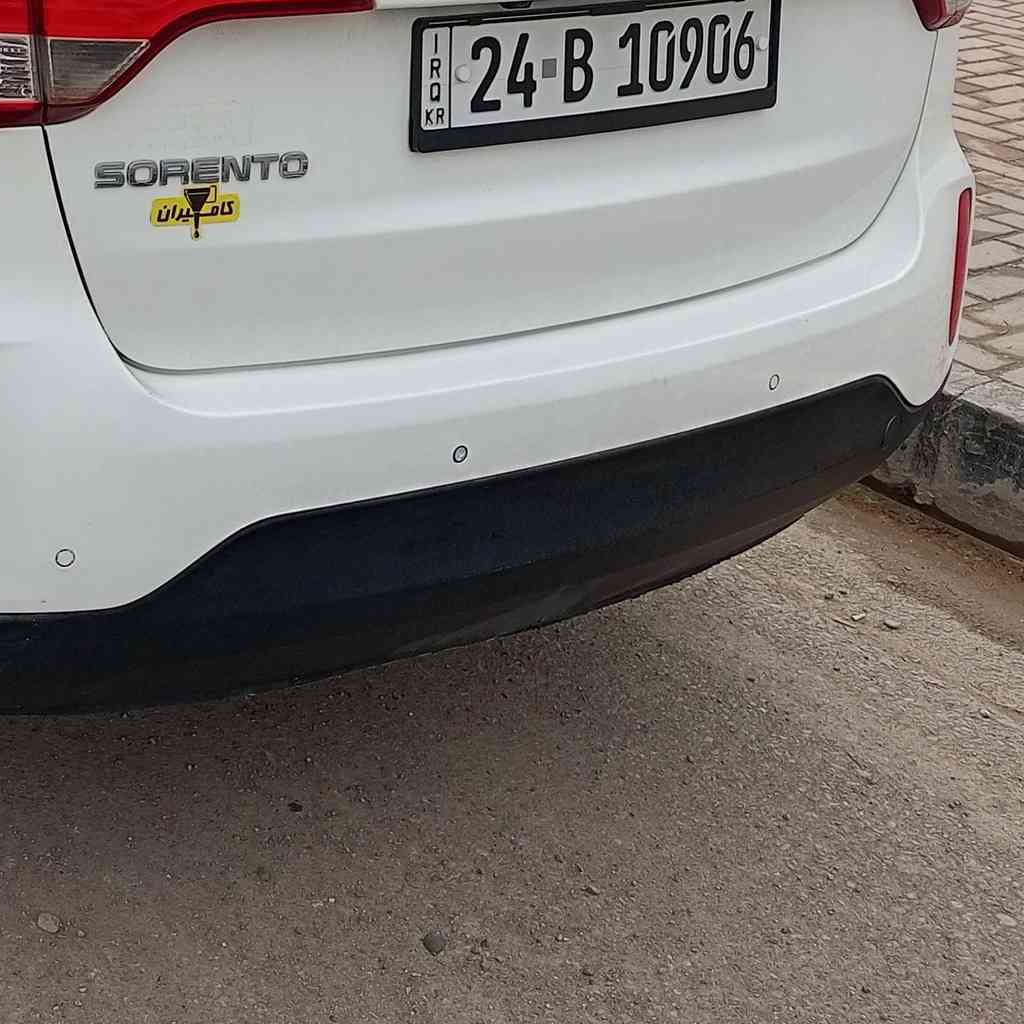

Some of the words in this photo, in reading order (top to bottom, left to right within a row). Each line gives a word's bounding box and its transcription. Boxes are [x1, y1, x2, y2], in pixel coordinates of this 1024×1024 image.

[470, 33, 537, 113] 24
[563, 28, 594, 103] B
[617, 10, 755, 97] 10906
[425, 108, 446, 127] KR
[94, 151, 309, 189] SORENTO
